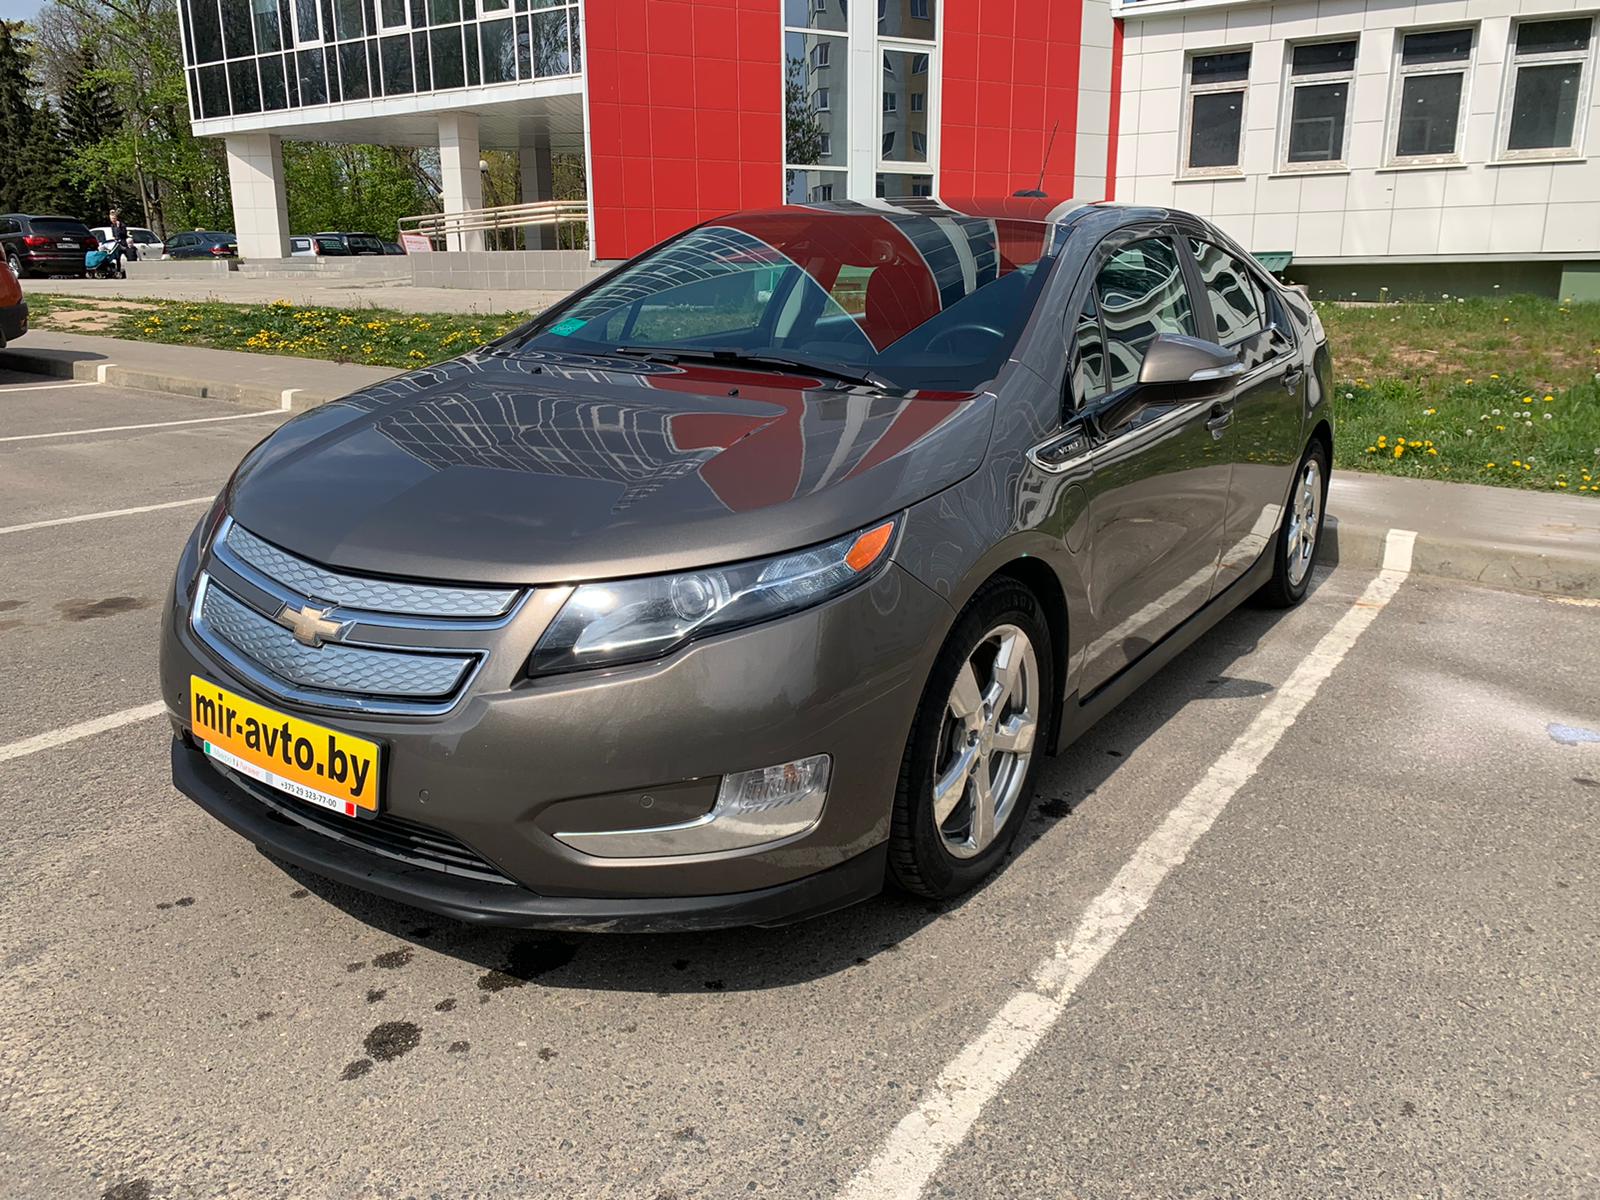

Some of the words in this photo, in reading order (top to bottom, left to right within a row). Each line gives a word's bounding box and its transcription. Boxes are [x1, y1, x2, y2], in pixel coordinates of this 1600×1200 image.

[195, 692, 371, 797] mir-avto.by
[280, 782, 295, 793] +375
[296, 786, 304, 796] 29
[305, 790, 337, 808] 323-77-00
